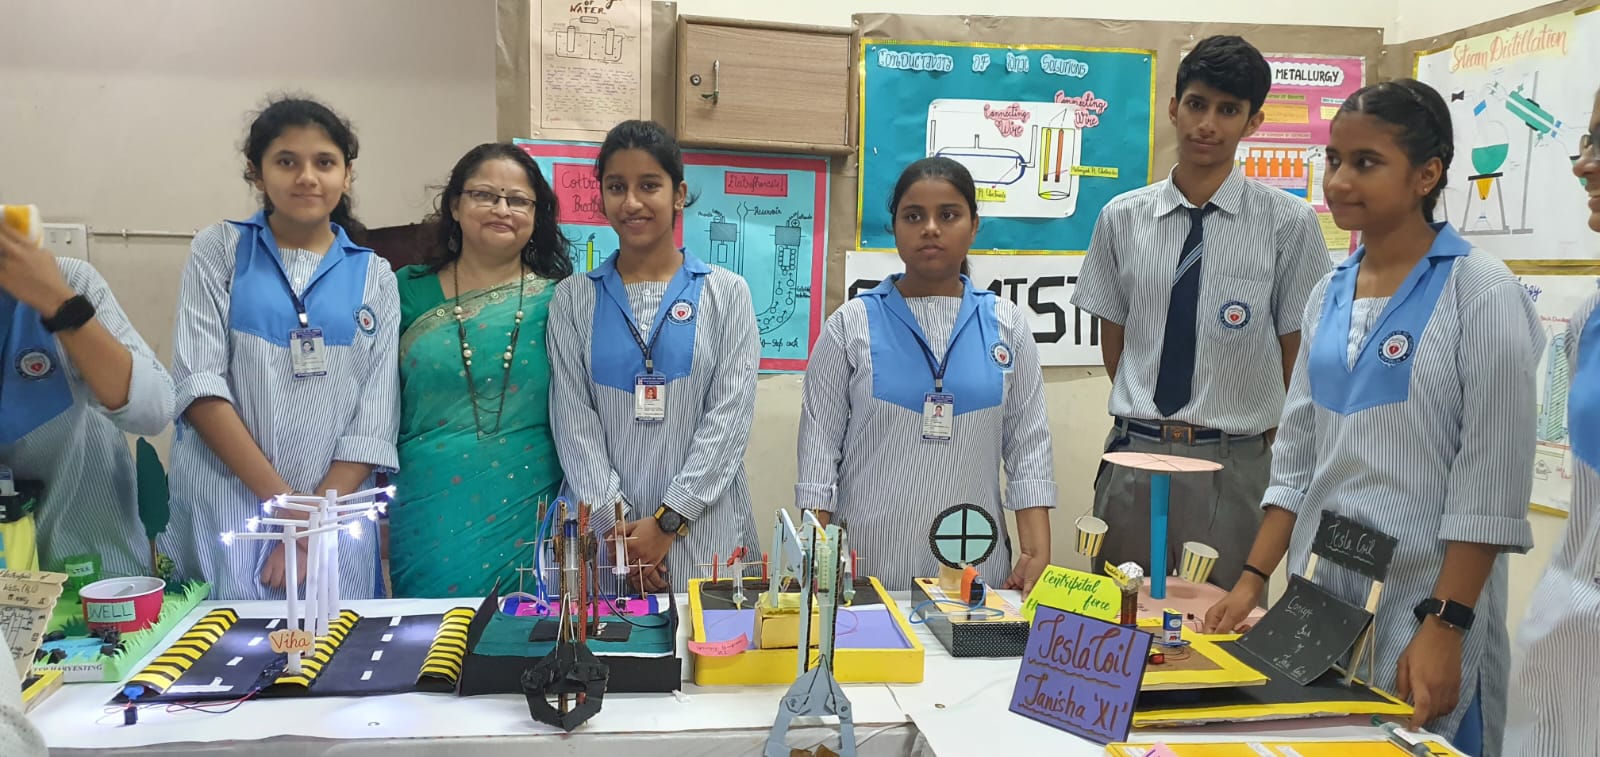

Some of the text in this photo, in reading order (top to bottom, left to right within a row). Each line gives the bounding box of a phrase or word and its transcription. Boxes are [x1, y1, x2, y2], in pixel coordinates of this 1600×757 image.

[569, 3, 605, 14] WATER
[1490, 24, 1567, 63] Distillation
[1275, 69, 1340, 82] METALLURGY
[1075, 110, 1097, 126] Wire
[1083, 595, 1110, 610] force
[88, 604, 132, 619] WELL
[271, 634, 309, 649] Viha
[1038, 614, 1090, 673] Tesla
